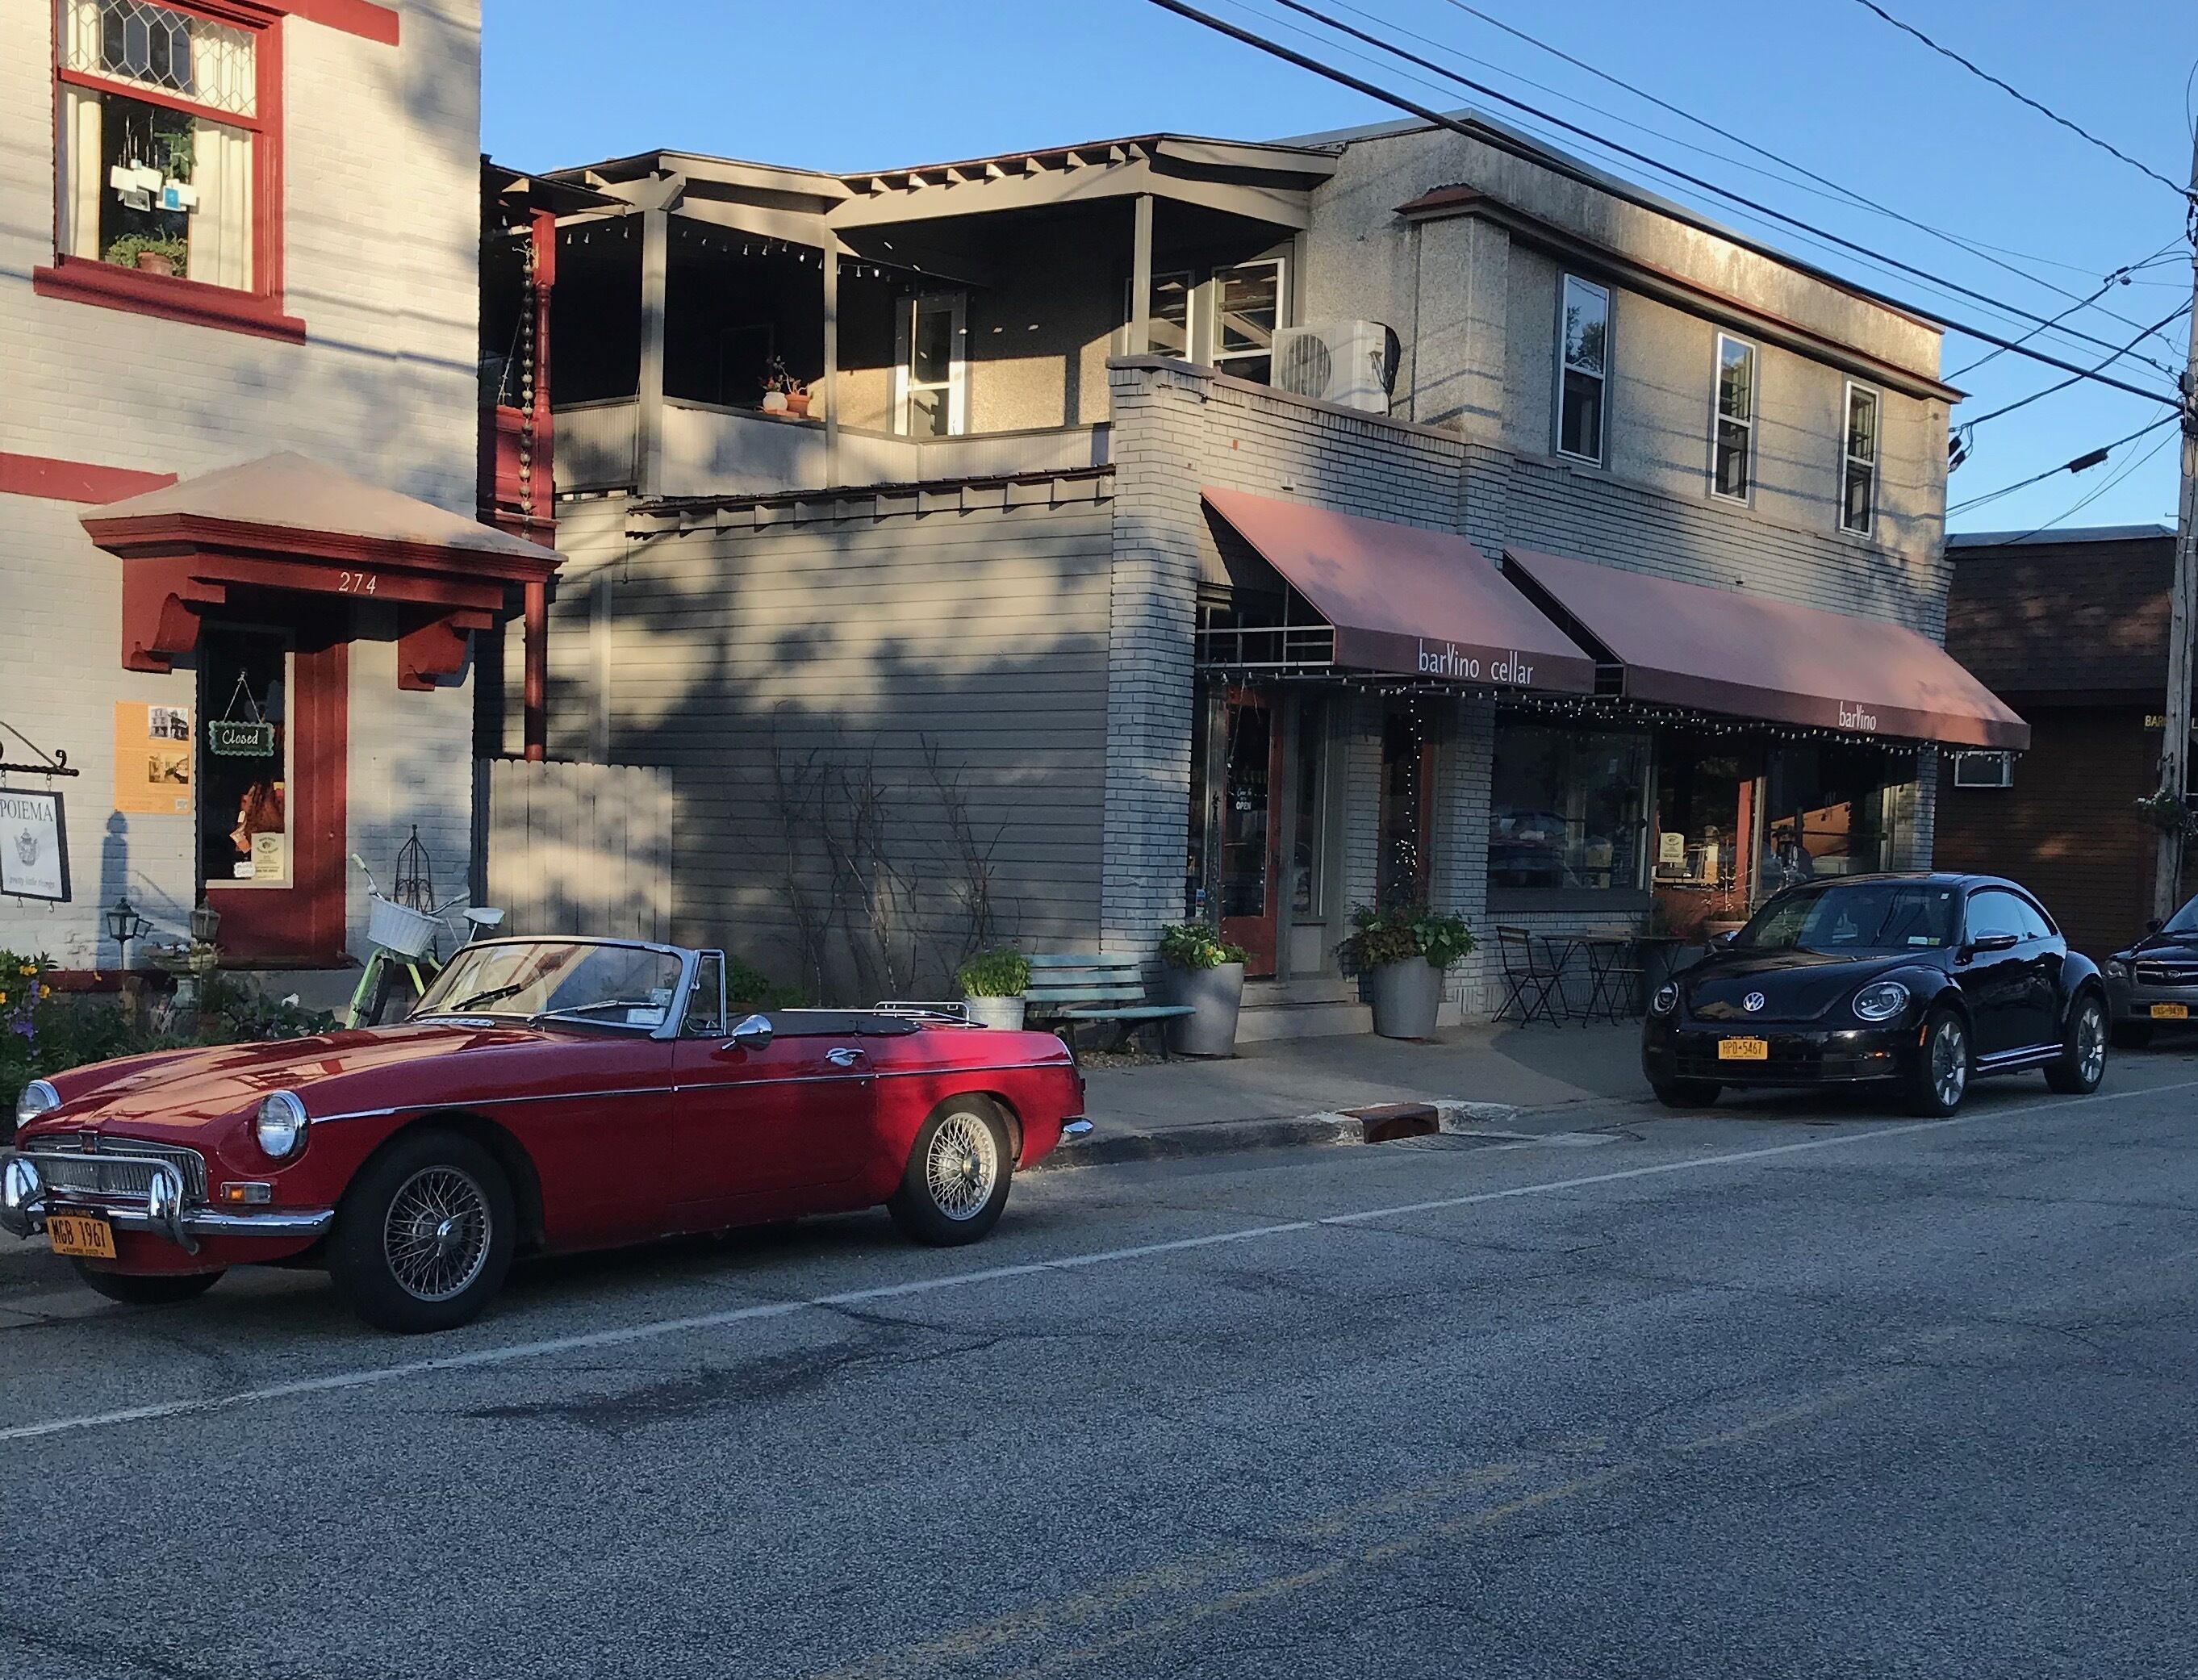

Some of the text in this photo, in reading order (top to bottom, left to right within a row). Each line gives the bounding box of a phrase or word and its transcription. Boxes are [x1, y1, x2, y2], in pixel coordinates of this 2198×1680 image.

[338, 571, 377, 595] 274
[1419, 638, 1534, 684] barVino cellar
[1839, 700, 1877, 731] barVino
[222, 729, 259, 745] Closed
[0, 799, 53, 822] POIEMA
[50, 1218, 107, 1248] MGB 1967
